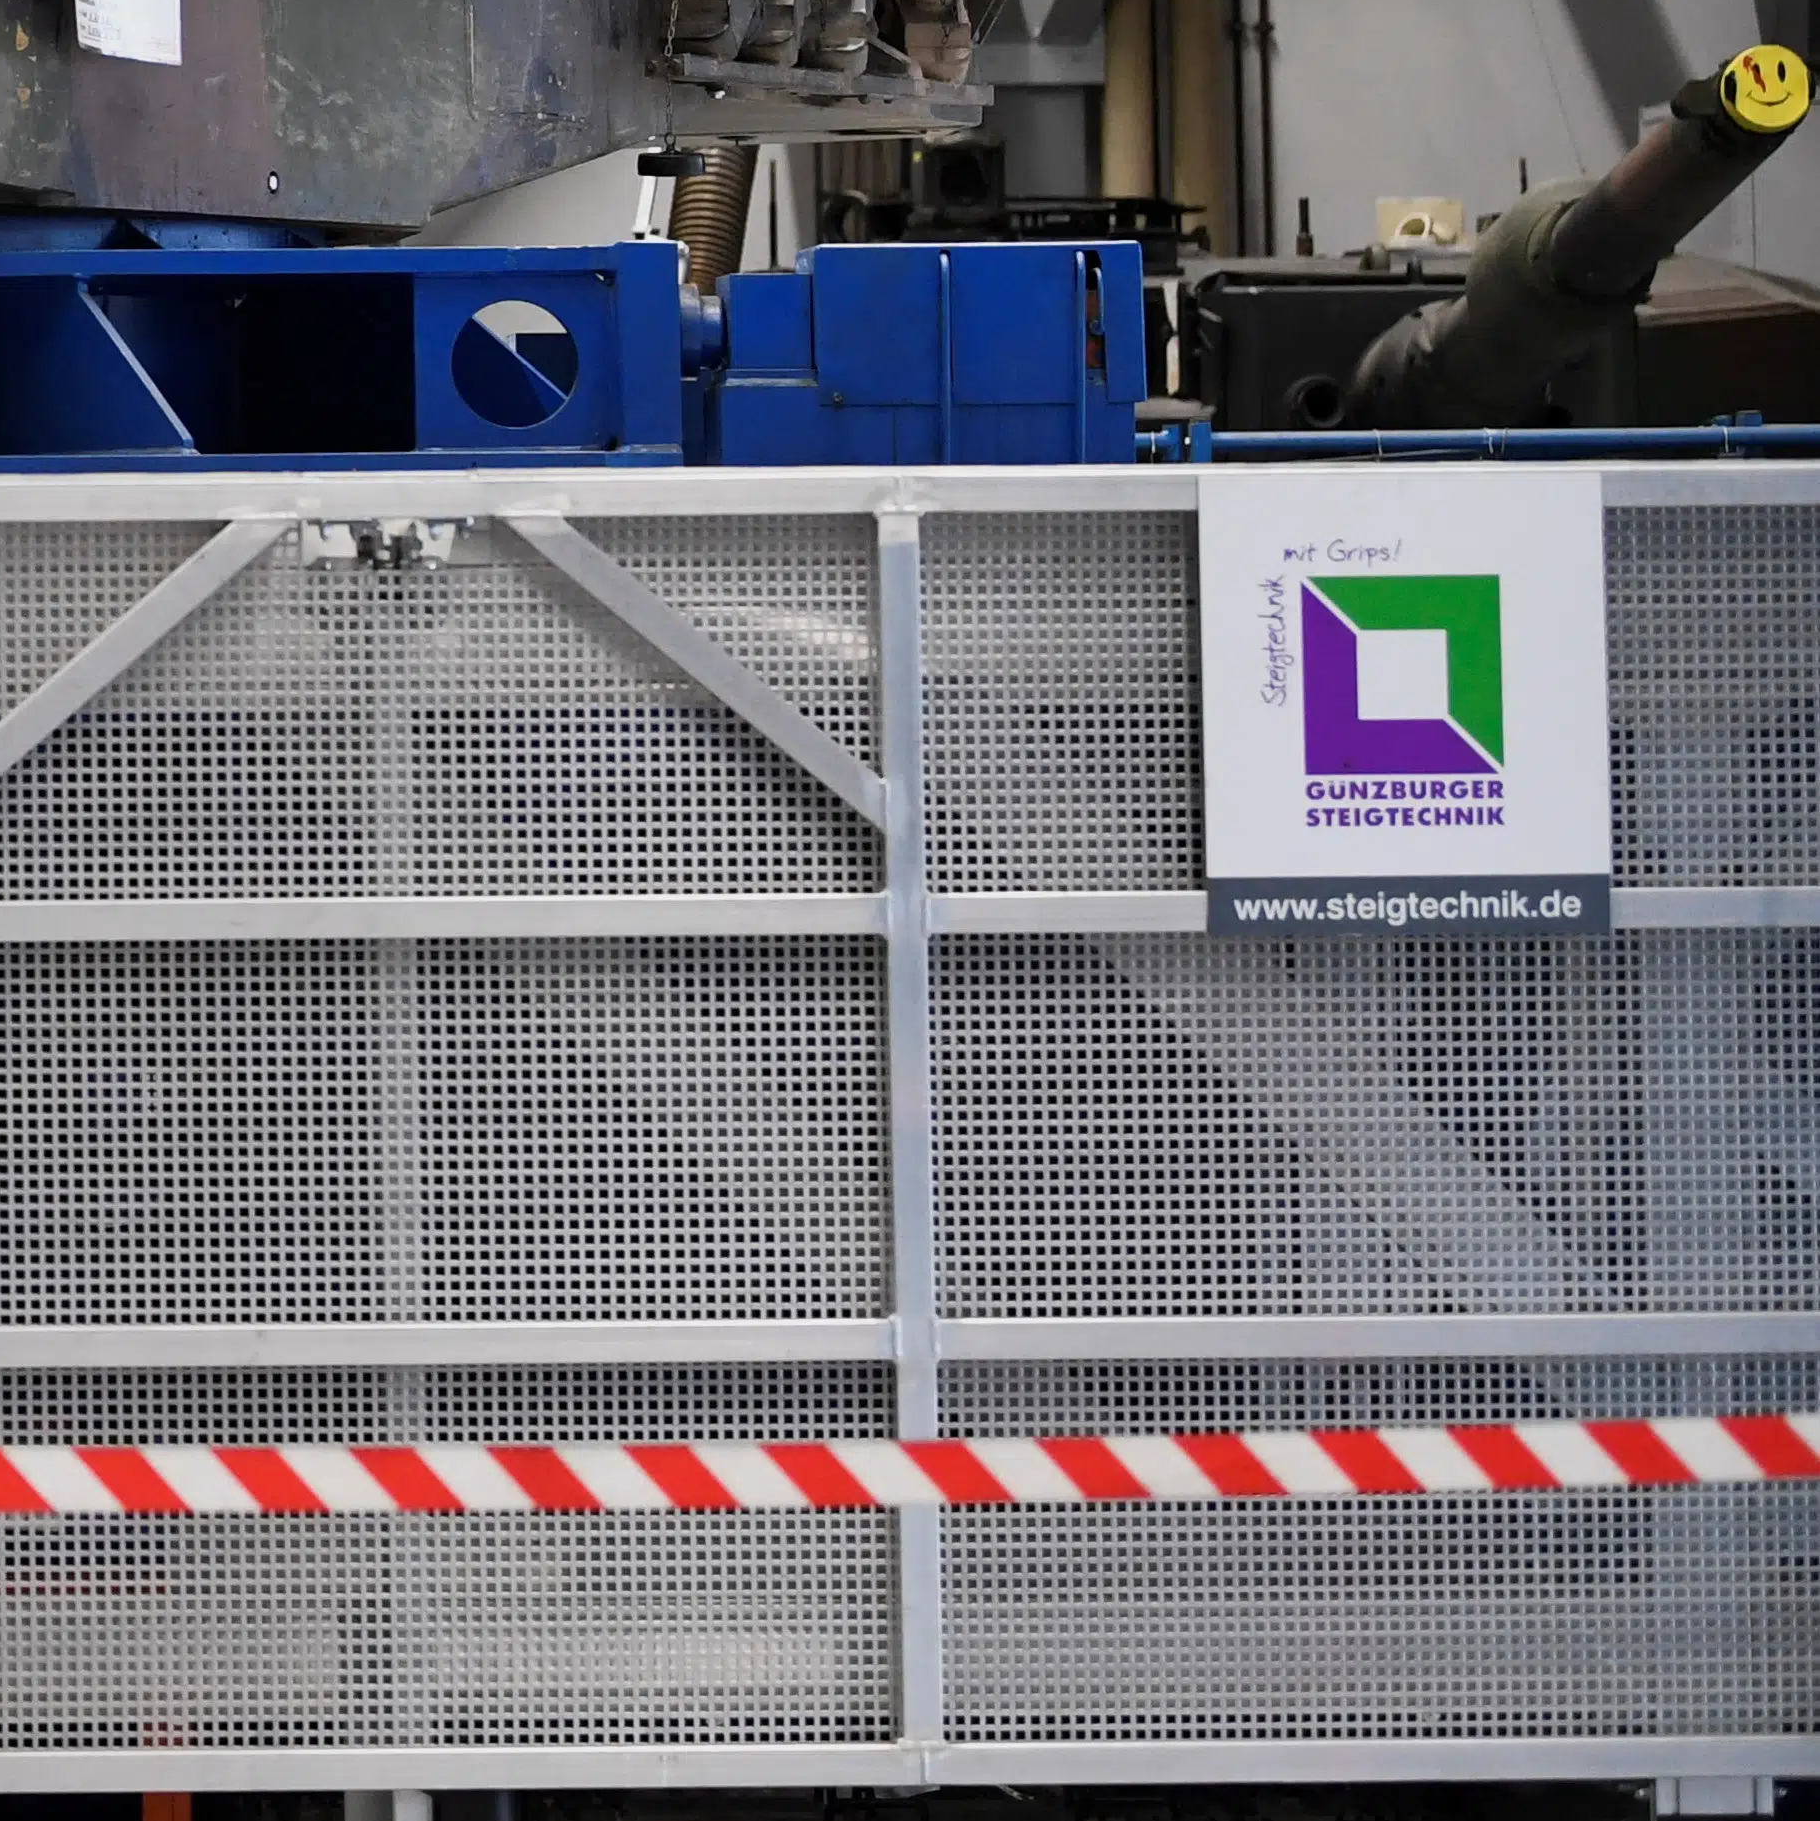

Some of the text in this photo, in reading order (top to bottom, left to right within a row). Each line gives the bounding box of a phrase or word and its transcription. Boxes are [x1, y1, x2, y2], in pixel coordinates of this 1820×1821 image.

[1283, 538, 1402, 569] mit Grips!
[1259, 574, 1294, 708] Steigtechnik
[1305, 781, 1505, 800] GÜNZBURGER
[1305, 807, 1505, 827] STEIGTECHNIK
[1234, 889, 1582, 926] www.steigtechnik.de
